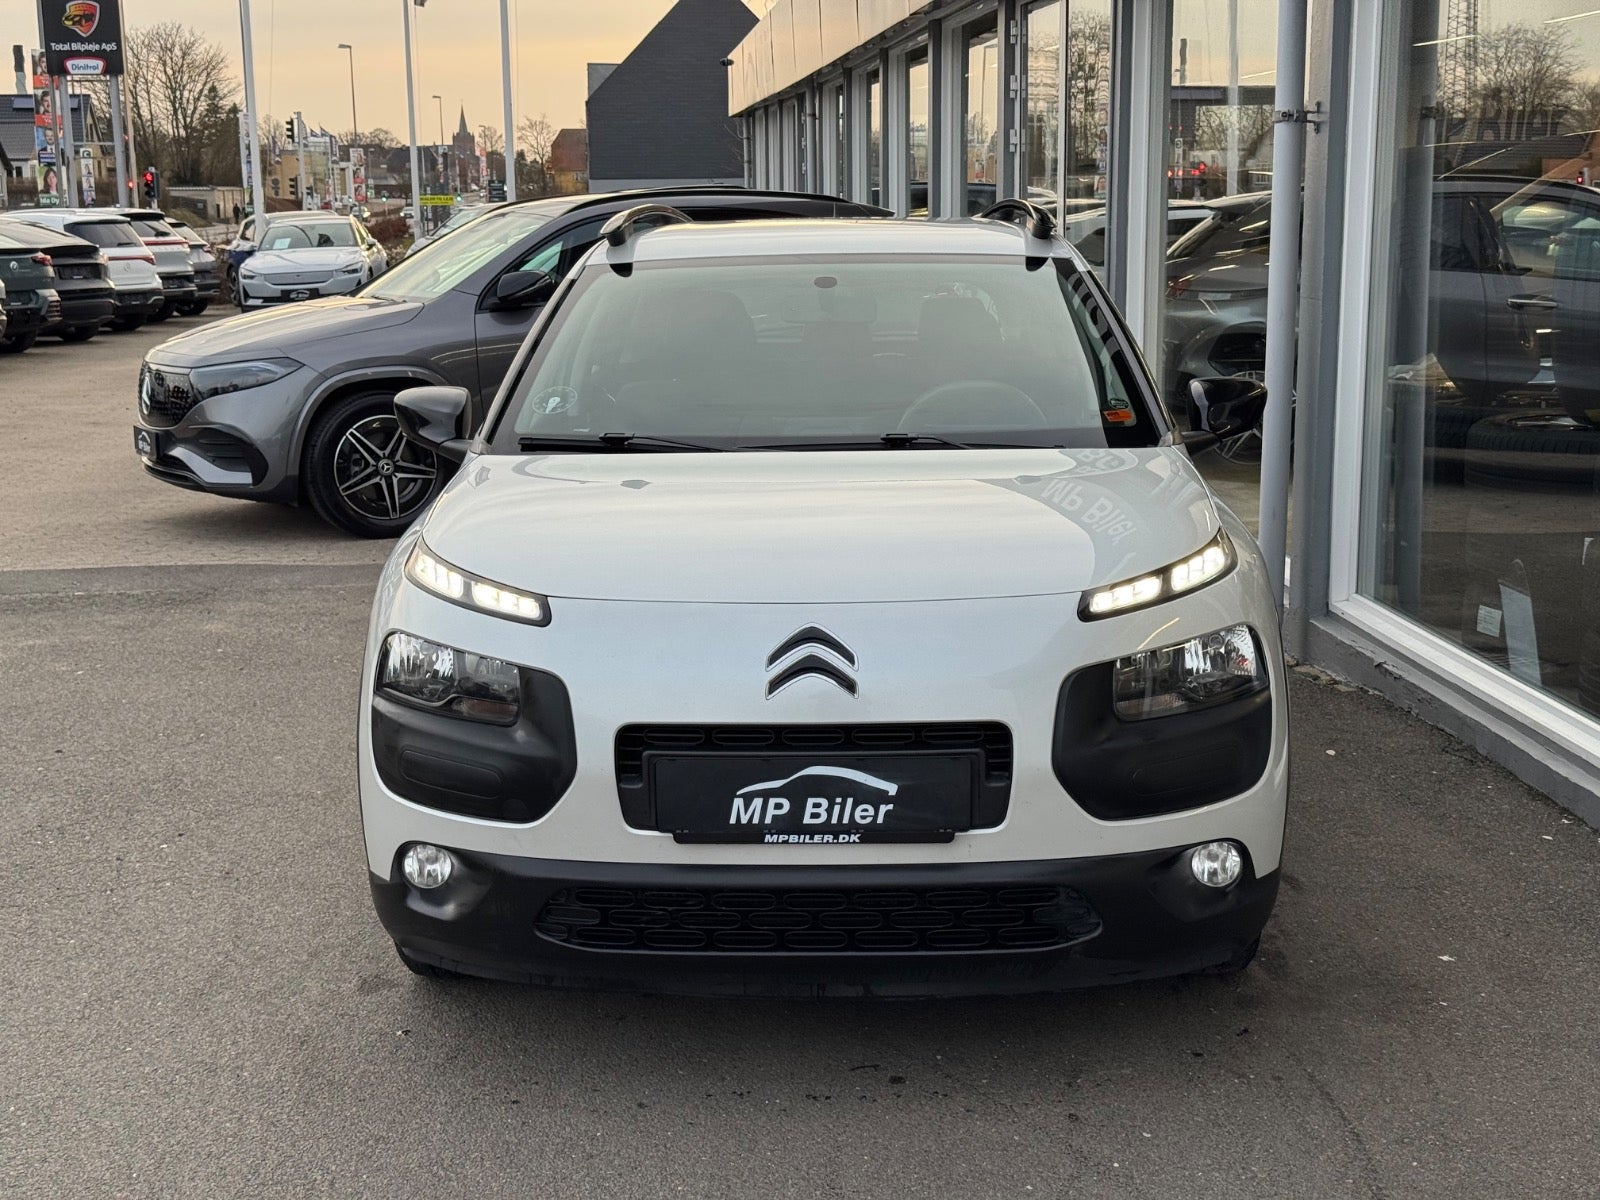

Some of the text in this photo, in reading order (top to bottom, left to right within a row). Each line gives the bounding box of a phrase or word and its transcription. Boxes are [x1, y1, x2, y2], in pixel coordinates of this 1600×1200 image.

[50, 42, 117, 52] Total Bilpleje ApS
[71, 63, 99, 71] Dinitrol
[730, 797, 893, 825] MP Biler
[764, 834, 861, 843] MPBILER.DK
